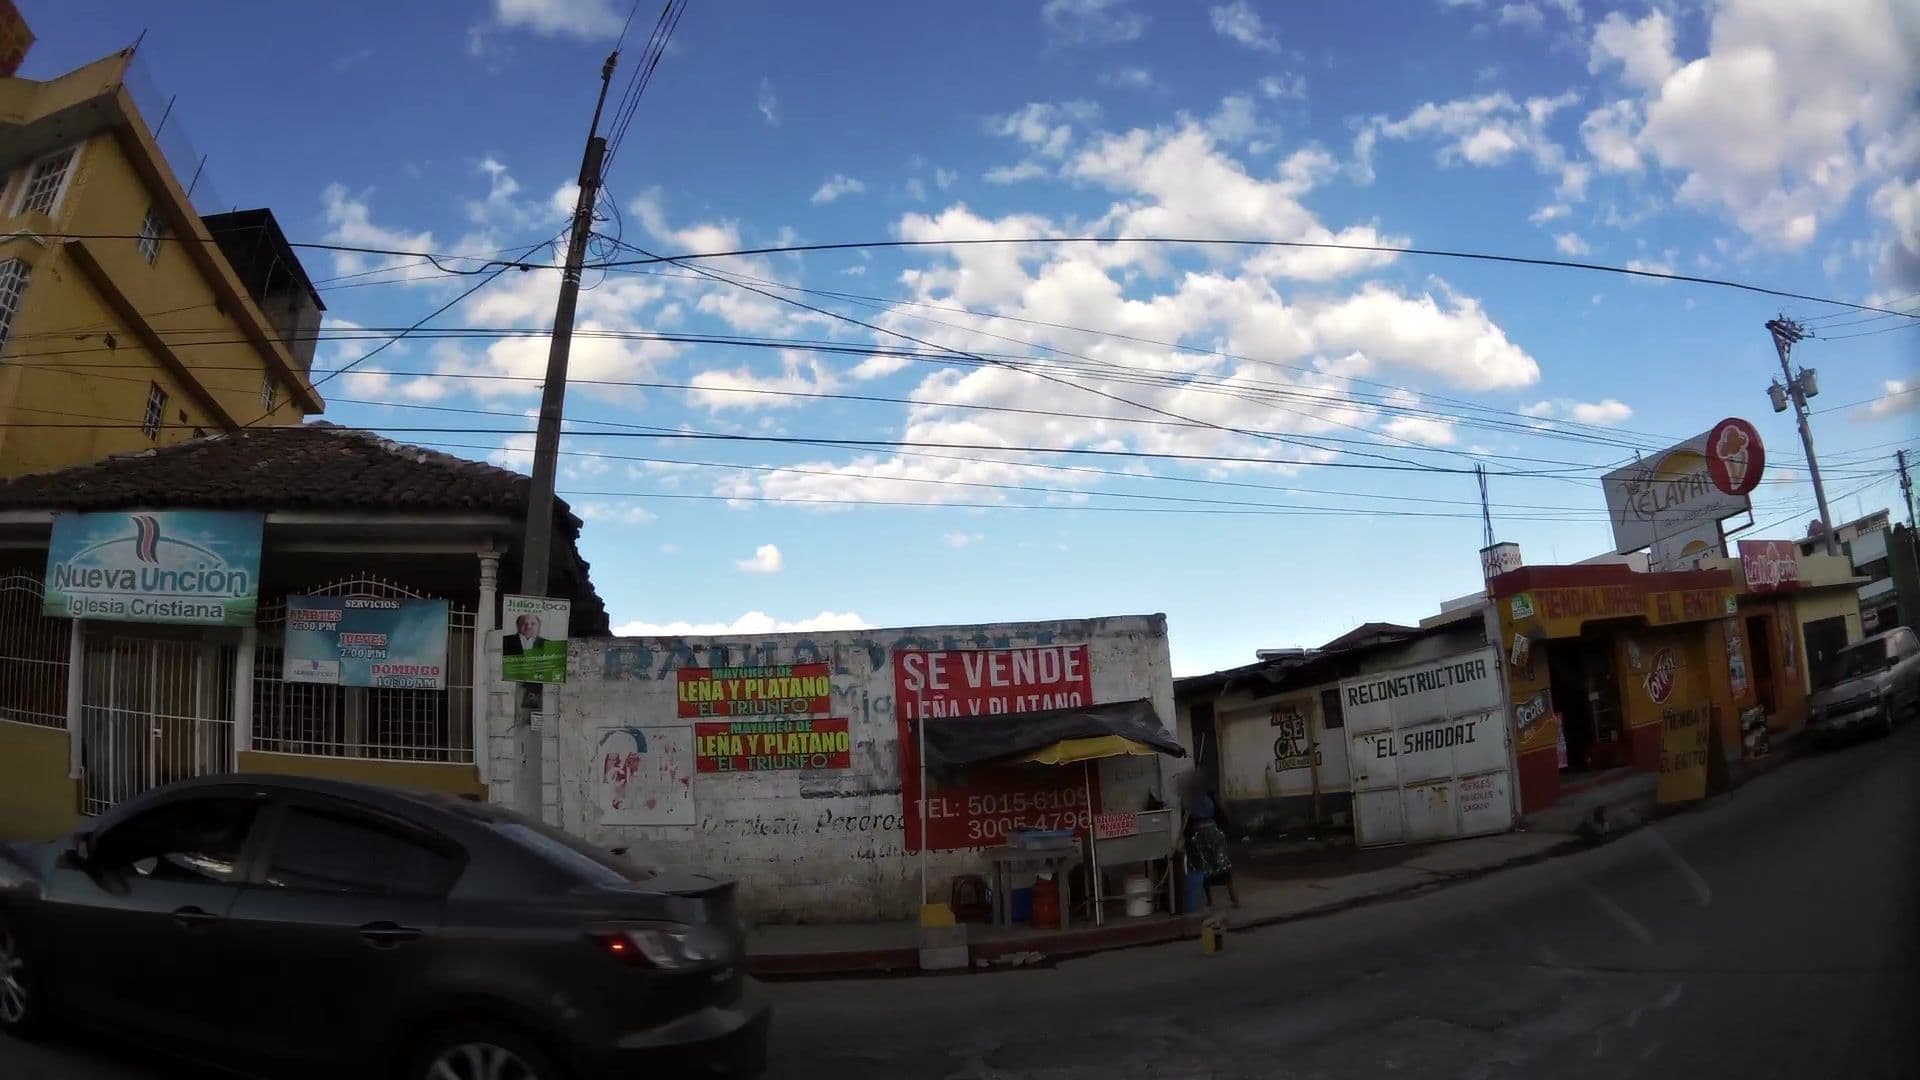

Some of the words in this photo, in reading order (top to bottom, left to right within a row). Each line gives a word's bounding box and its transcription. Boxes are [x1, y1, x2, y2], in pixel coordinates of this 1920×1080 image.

[55, 564, 138, 591] Nueva
[141, 562, 250, 597] Unción
[69, 596, 125, 616] Iglesia
[131, 599, 225, 618] Cristiana
[318, 623, 337, 632] PM
[371, 664, 441, 676] DOMINGO
[776, 665, 793, 678] DE
[903, 651, 950, 692] SE
[961, 646, 1085, 688] VENDE
[679, 677, 725, 702] LEÑA
[727, 679, 741, 700] Y
[744, 676, 830, 700] PLATANO
[1348, 658, 1487, 707] RECONSTRUCTORA
[795, 720, 813, 733] DE
[696, 731, 744, 757] LEÑA
[745, 733, 760, 755] Y
[763, 731, 849, 755] PLATANO
[914, 797, 961, 819] TEL:
